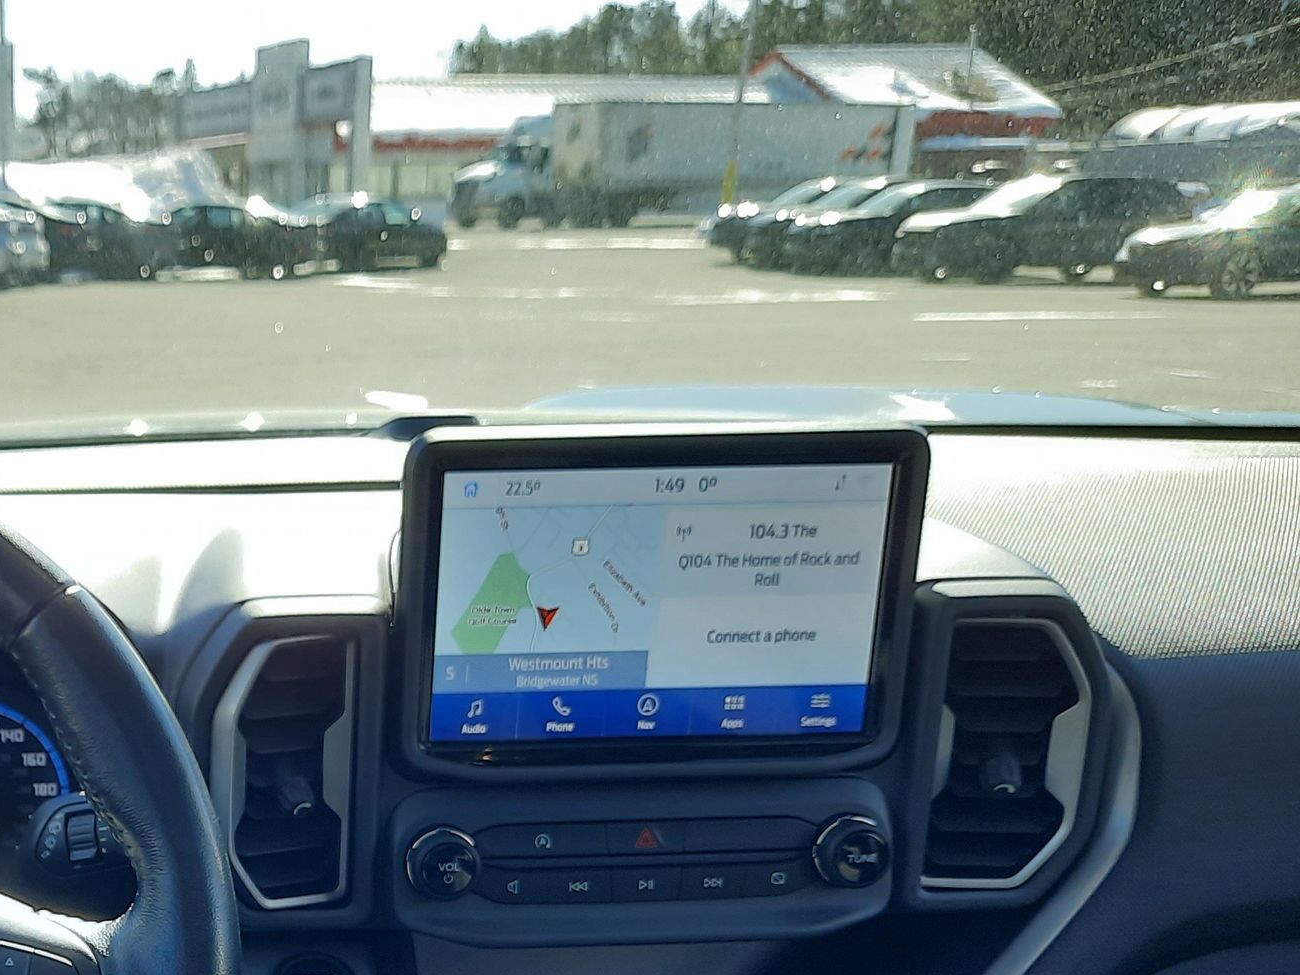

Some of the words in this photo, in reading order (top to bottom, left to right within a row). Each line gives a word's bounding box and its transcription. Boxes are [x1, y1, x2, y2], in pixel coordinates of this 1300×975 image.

[655, 478, 685, 493] 1:49
[750, 524, 789, 540] 104.3
[793, 524, 818, 538] The
[678, 554, 712, 571] Q104
[716, 554, 739, 568] The
[741, 553, 781, 567] Home
[783, 552, 798, 567] of
[800, 551, 831, 566] Rock
[833, 550, 860, 566] and
[754, 572, 780, 587] Roll
[707, 630, 760, 643] Connect
[763, 633, 771, 642] a
[774, 629, 816, 644] phone
[508, 657, 584, 671] Westmount
[586, 656, 609, 670] Hts
[446, 666, 455, 680] S
[516, 675, 579, 689] Bridgewater
[582, 673, 598, 685] NS
[461, 723, 487, 734] Audio
[546, 722, 574, 732] Phone
[637, 720, 655, 730] Nav
[720, 718, 744, 730] Apps
[800, 716, 837, 728] Settings
[0, 730, 25, 743] 140
[846, 853, 878, 864] TUNE
[437, 862, 461, 872] VOL
